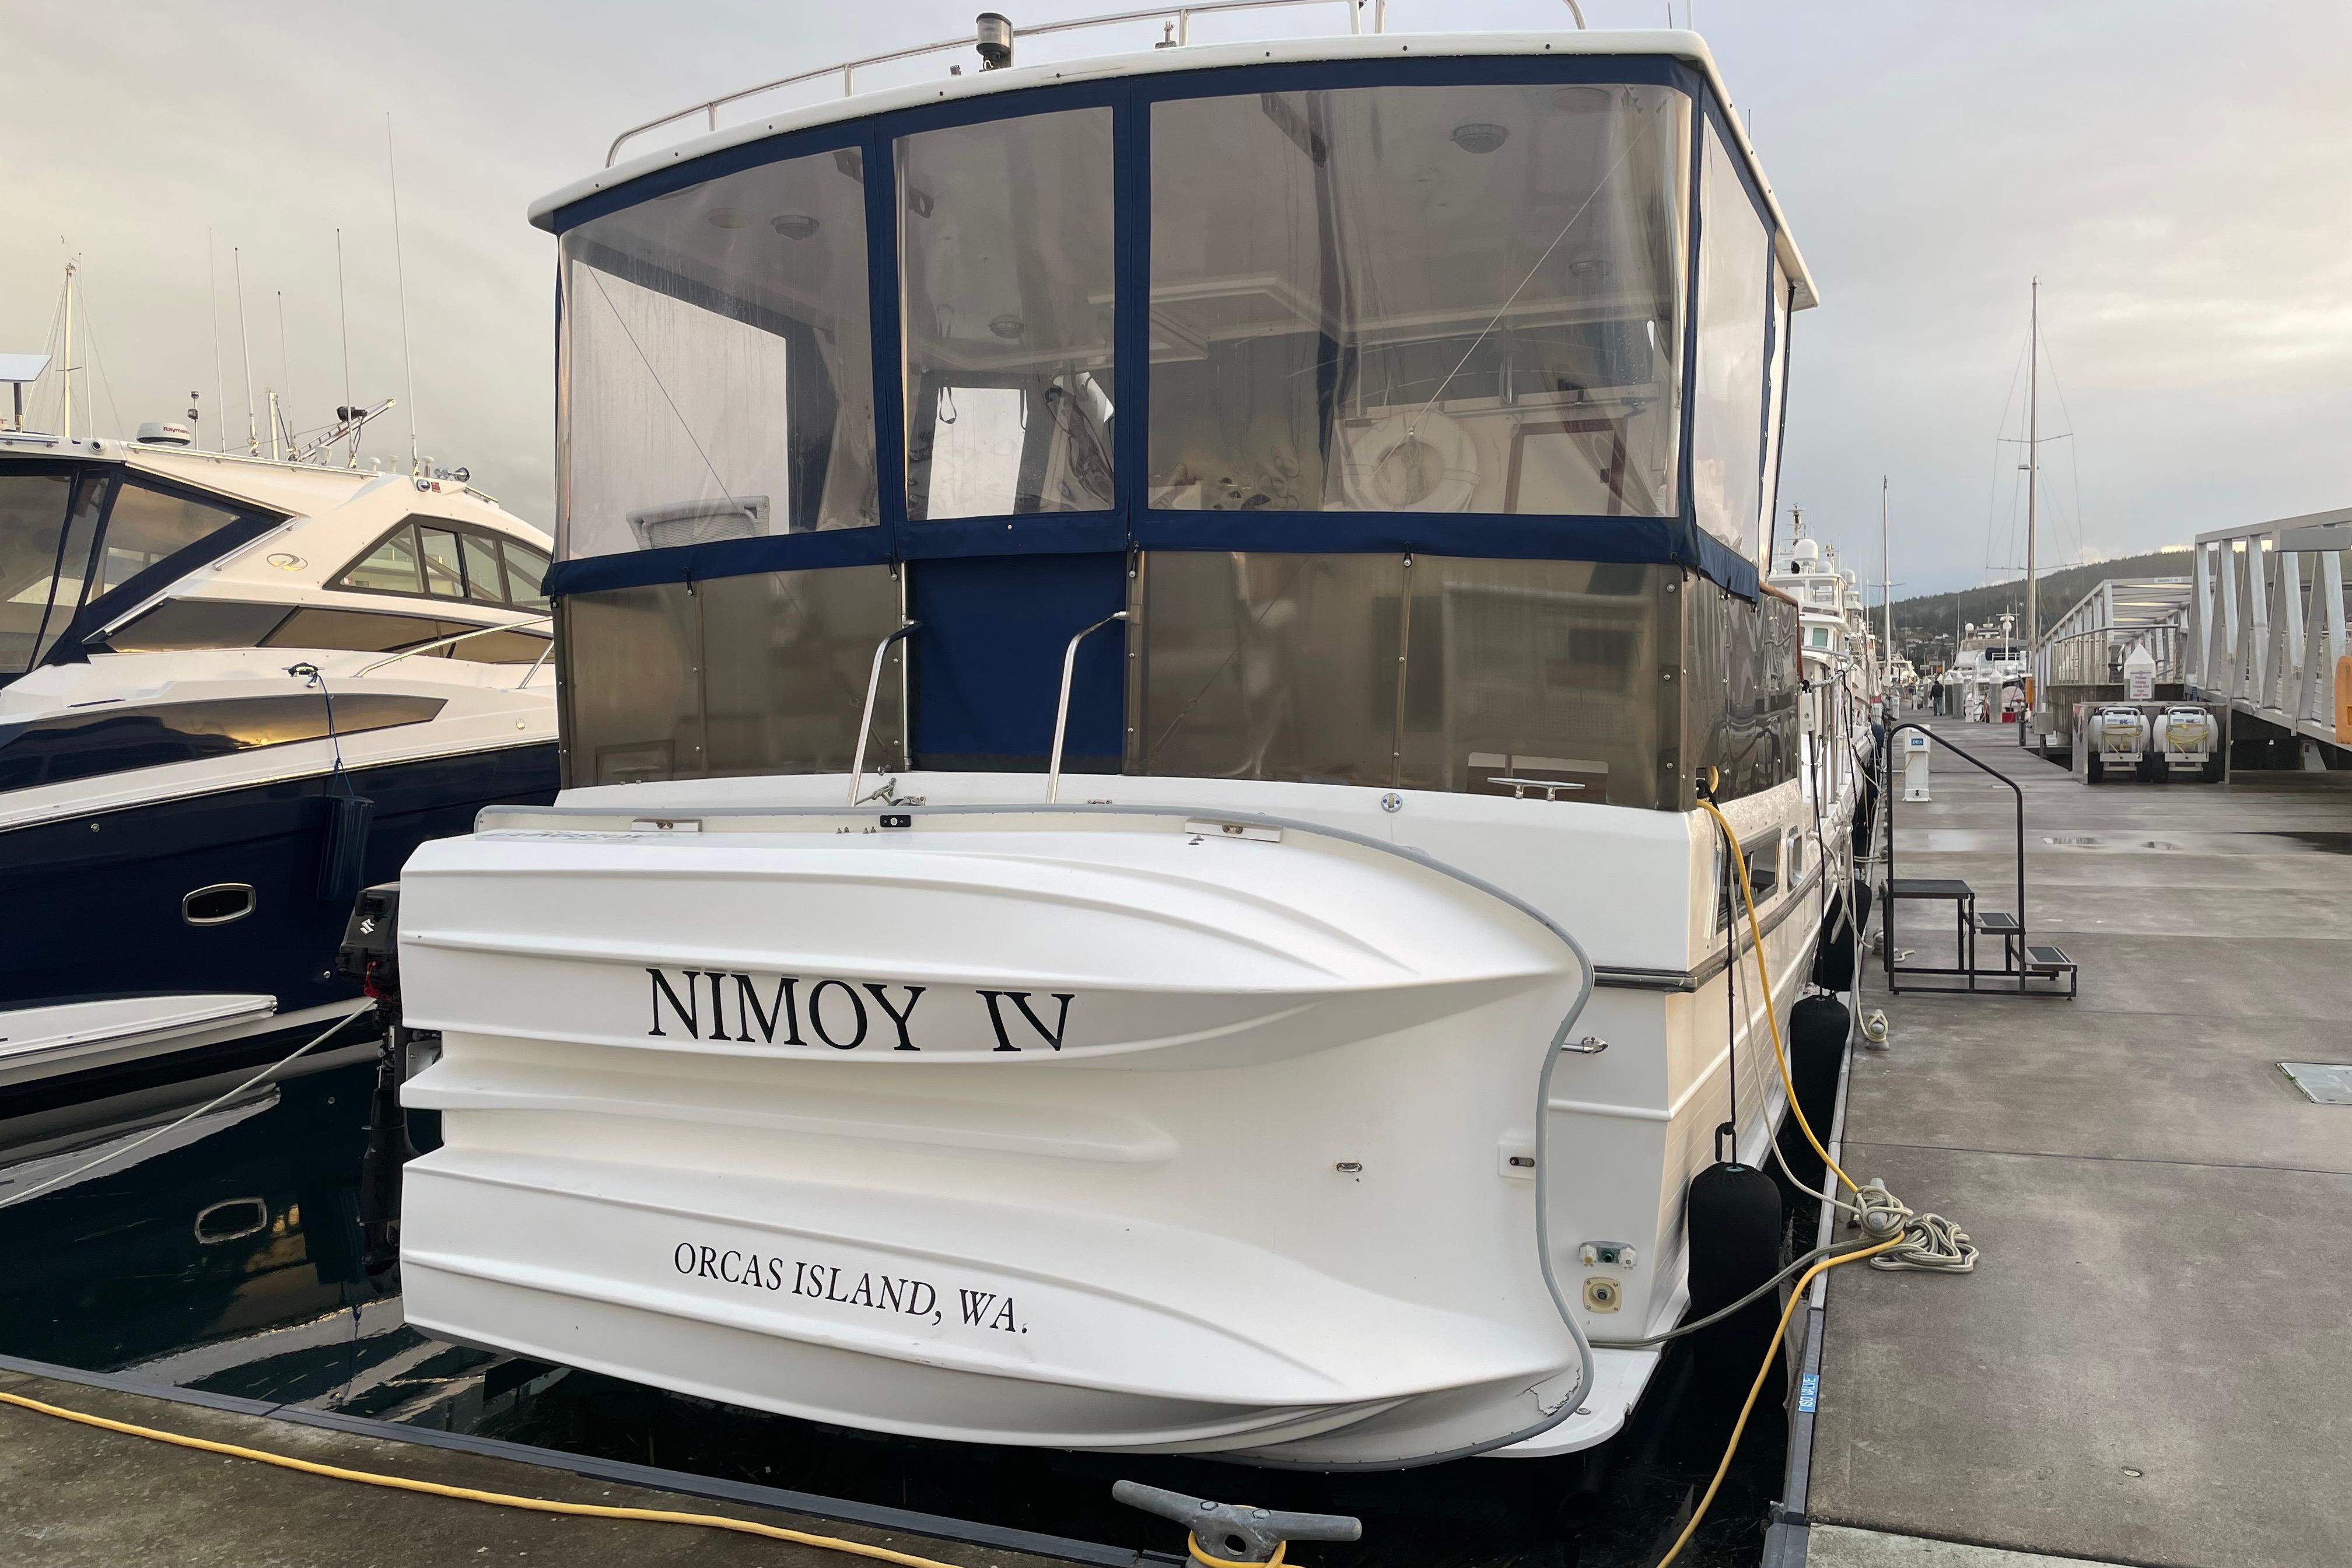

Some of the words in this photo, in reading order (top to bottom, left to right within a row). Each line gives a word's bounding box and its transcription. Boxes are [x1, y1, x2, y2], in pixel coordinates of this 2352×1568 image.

[645, 968, 927, 1051] NIMOY
[975, 989, 1075, 1052] IV
[674, 1242, 783, 1290] ORCAS
[792, 1262, 942, 1326] ISLAND,
[959, 1289, 1028, 1334] WA.
[1799, 1396, 1814, 1408] ISO
[1801, 1378, 1816, 1395] VALVE
